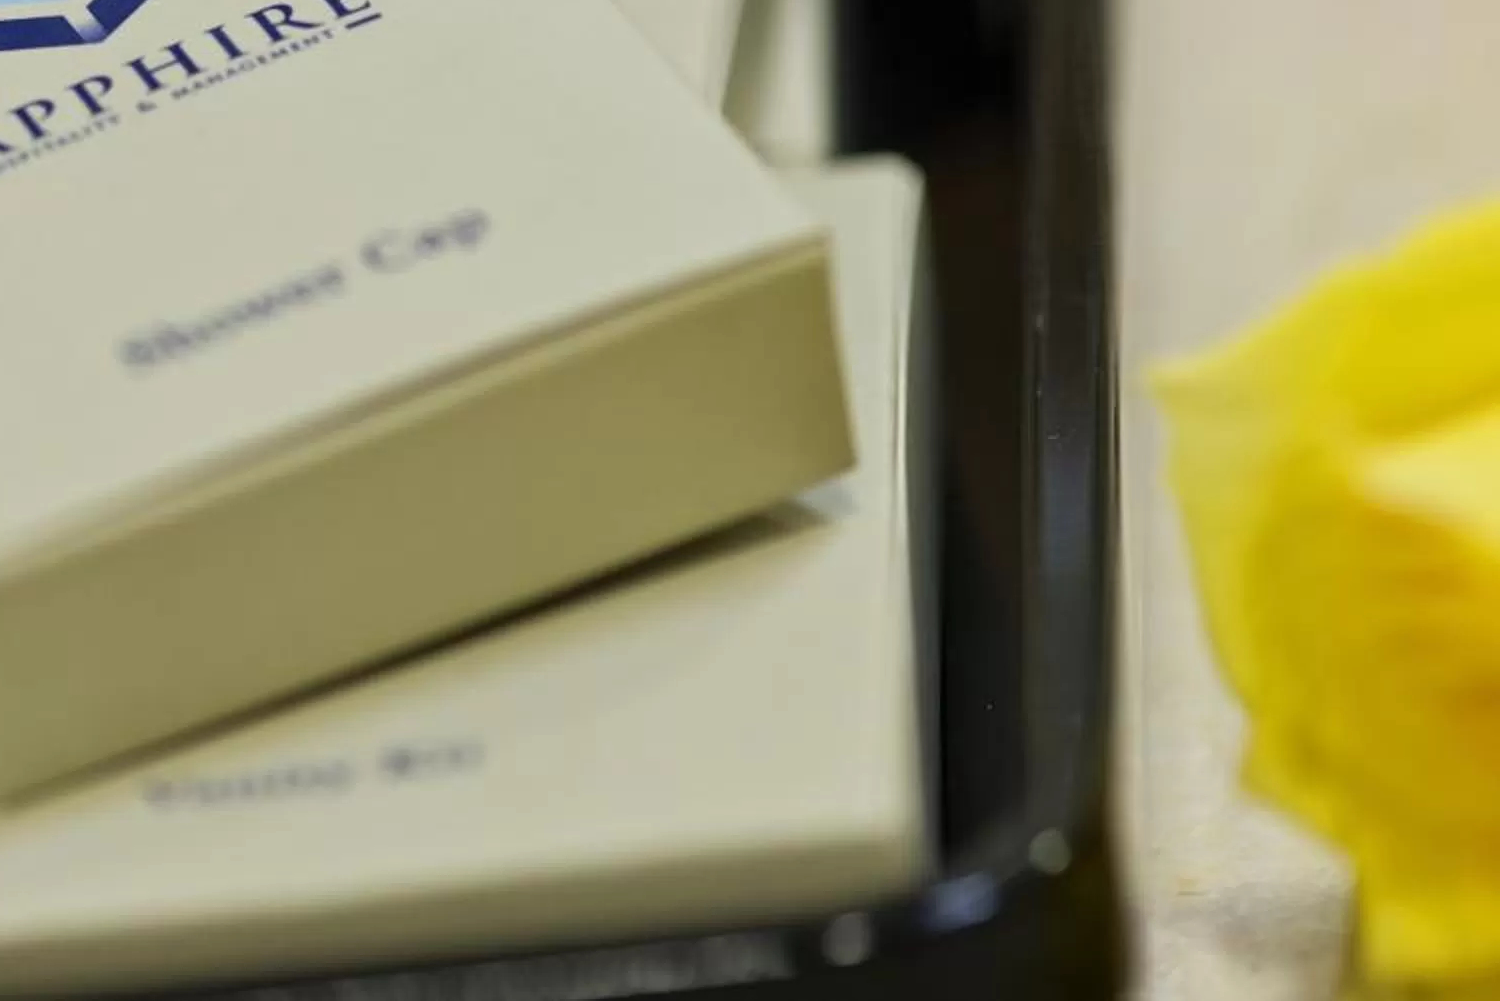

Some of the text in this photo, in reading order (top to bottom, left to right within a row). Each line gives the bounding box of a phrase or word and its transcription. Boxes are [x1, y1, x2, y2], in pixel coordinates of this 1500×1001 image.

[135, 100, 158, 114] &
[170, 27, 337, 100] MANAGEMENT
[357, 206, 492, 274] Cap
